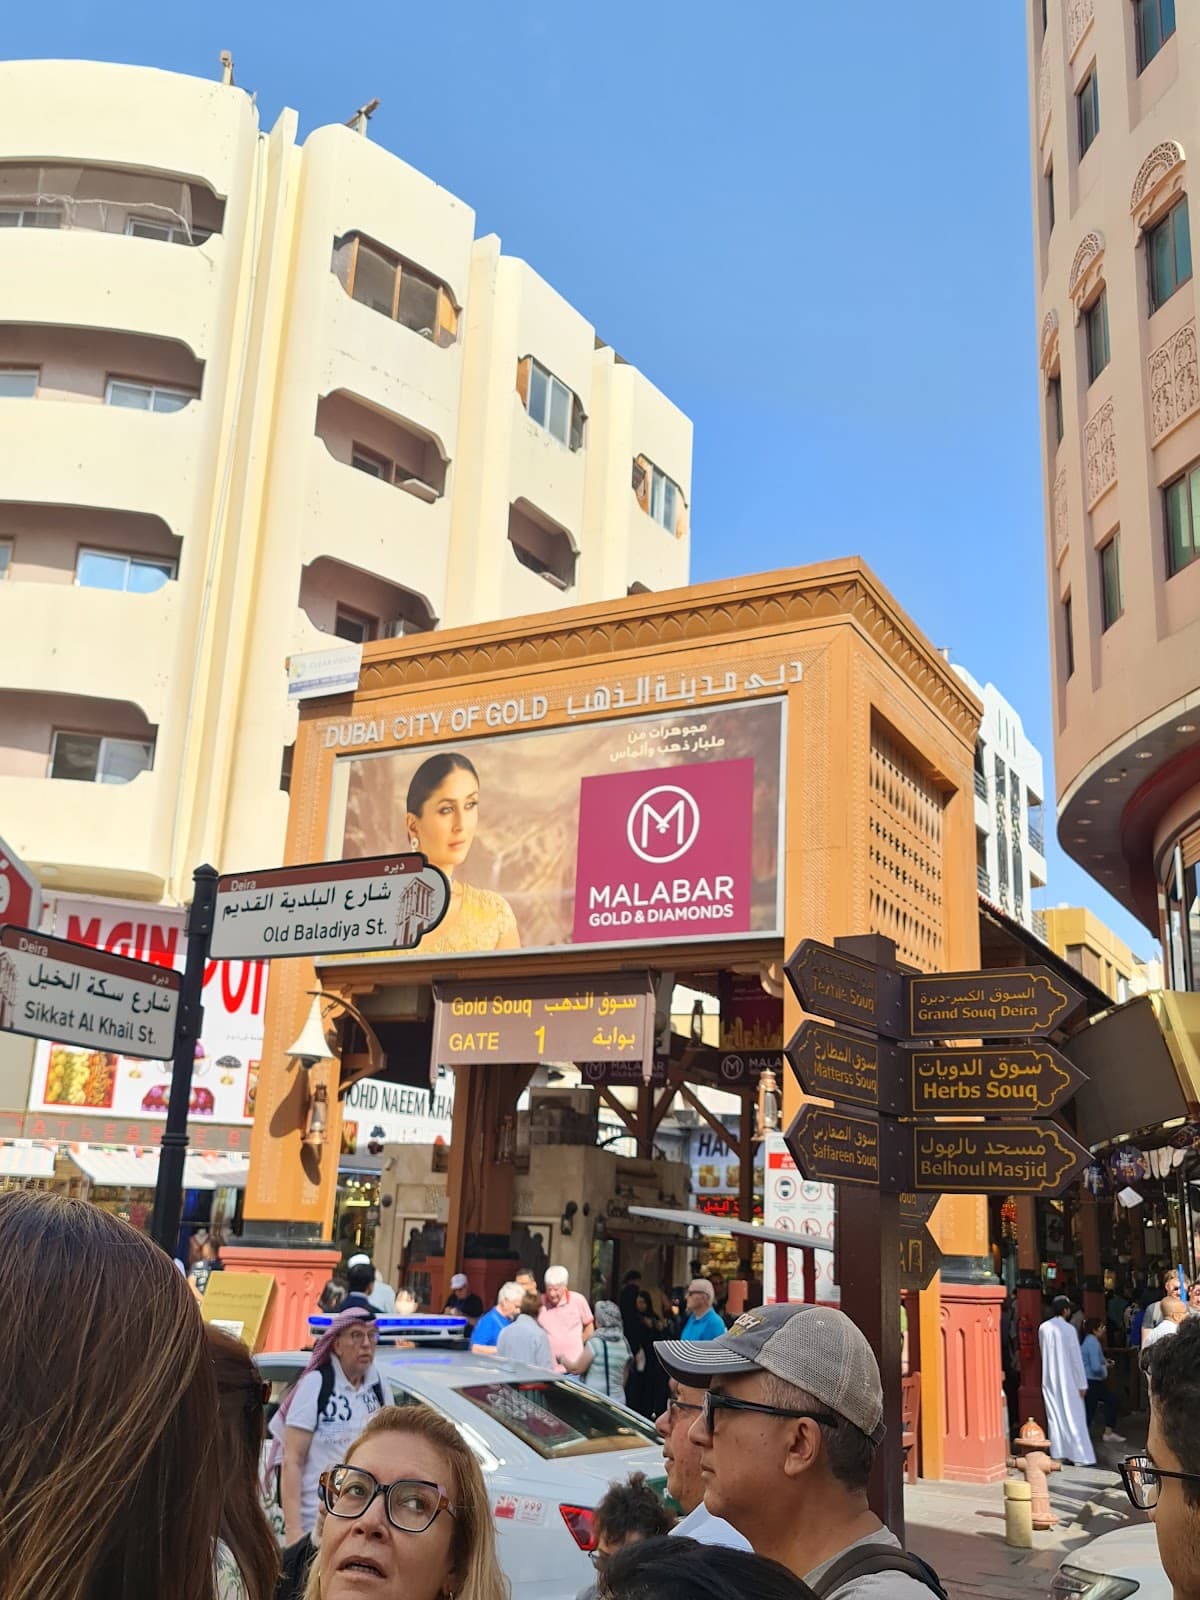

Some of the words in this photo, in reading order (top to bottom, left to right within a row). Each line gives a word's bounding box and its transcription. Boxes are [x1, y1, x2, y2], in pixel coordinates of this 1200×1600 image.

[655, 671, 737, 704] مدينة
[744, 660, 803, 693] دبي
[567, 675, 650, 717] الذهب
[325, 720, 385, 748] DUBAI
[392, 711, 444, 740] CITY
[451, 705, 480, 733] OF
[485, 696, 548, 727] GOLD
[649, 723, 708, 740] مجوهرات
[628, 730, 646, 744] من
[657, 739, 690, 753] ذهب
[230, 879, 256, 891] Deira
[344, 881, 392, 910] شارع
[589, 876, 734, 909] MALABAR
[222, 893, 274, 920] القديم
[280, 886, 335, 913] البلدية
[589, 911, 632, 926] GOLD
[634, 910, 645, 923] &
[647, 904, 734, 923] DIAMONDS
[263, 925, 289, 942] Old
[294, 920, 360, 941] Baladiya
[365, 918, 387, 936] St.
[18, 937, 48, 956] Deira
[28, 964, 80, 990] الخيل
[86, 975, 124, 1002] سكة
[131, 991, 171, 1013] شارع
[452, 997, 487, 1016] Gold
[492, 996, 532, 1017] Souq
[544, 991, 594, 1016] الذهب
[598, 992, 637, 1016] سوق
[989, 987, 1035, 1003] السوق
[24, 1001, 75, 1028] Sikkat
[78, 1012, 94, 1032] Al
[99, 1017, 134, 1040] Khail
[138, 1025, 157, 1044] St.
[918, 1006, 958, 1020] Grand
[962, 1007, 996, 1020] Souq
[1000, 1005, 1038, 1017] Deira
[449, 1032, 500, 1051] GATE
[534, 1026, 545, 1055] 1
[592, 1026, 636, 1050] بوابة
[852, 1053, 877, 1072] سوق
[989, 1057, 1042, 1079] سوق
[855, 1072, 877, 1095] Souq
[923, 1081, 981, 1099] Herbs
[986, 1081, 1038, 1101] Souq
[382, 1087, 425, 1117] NAEEM
[854, 1130, 877, 1147] سوق
[921, 1137, 977, 1158] بالهول
[984, 1141, 1046, 1156] مسجد
[813, 1143, 855, 1163] Saffareen
[856, 1152, 877, 1170] Souq
[921, 1160, 985, 1176] Belhoul
[988, 1161, 1047, 1180] Masjid
